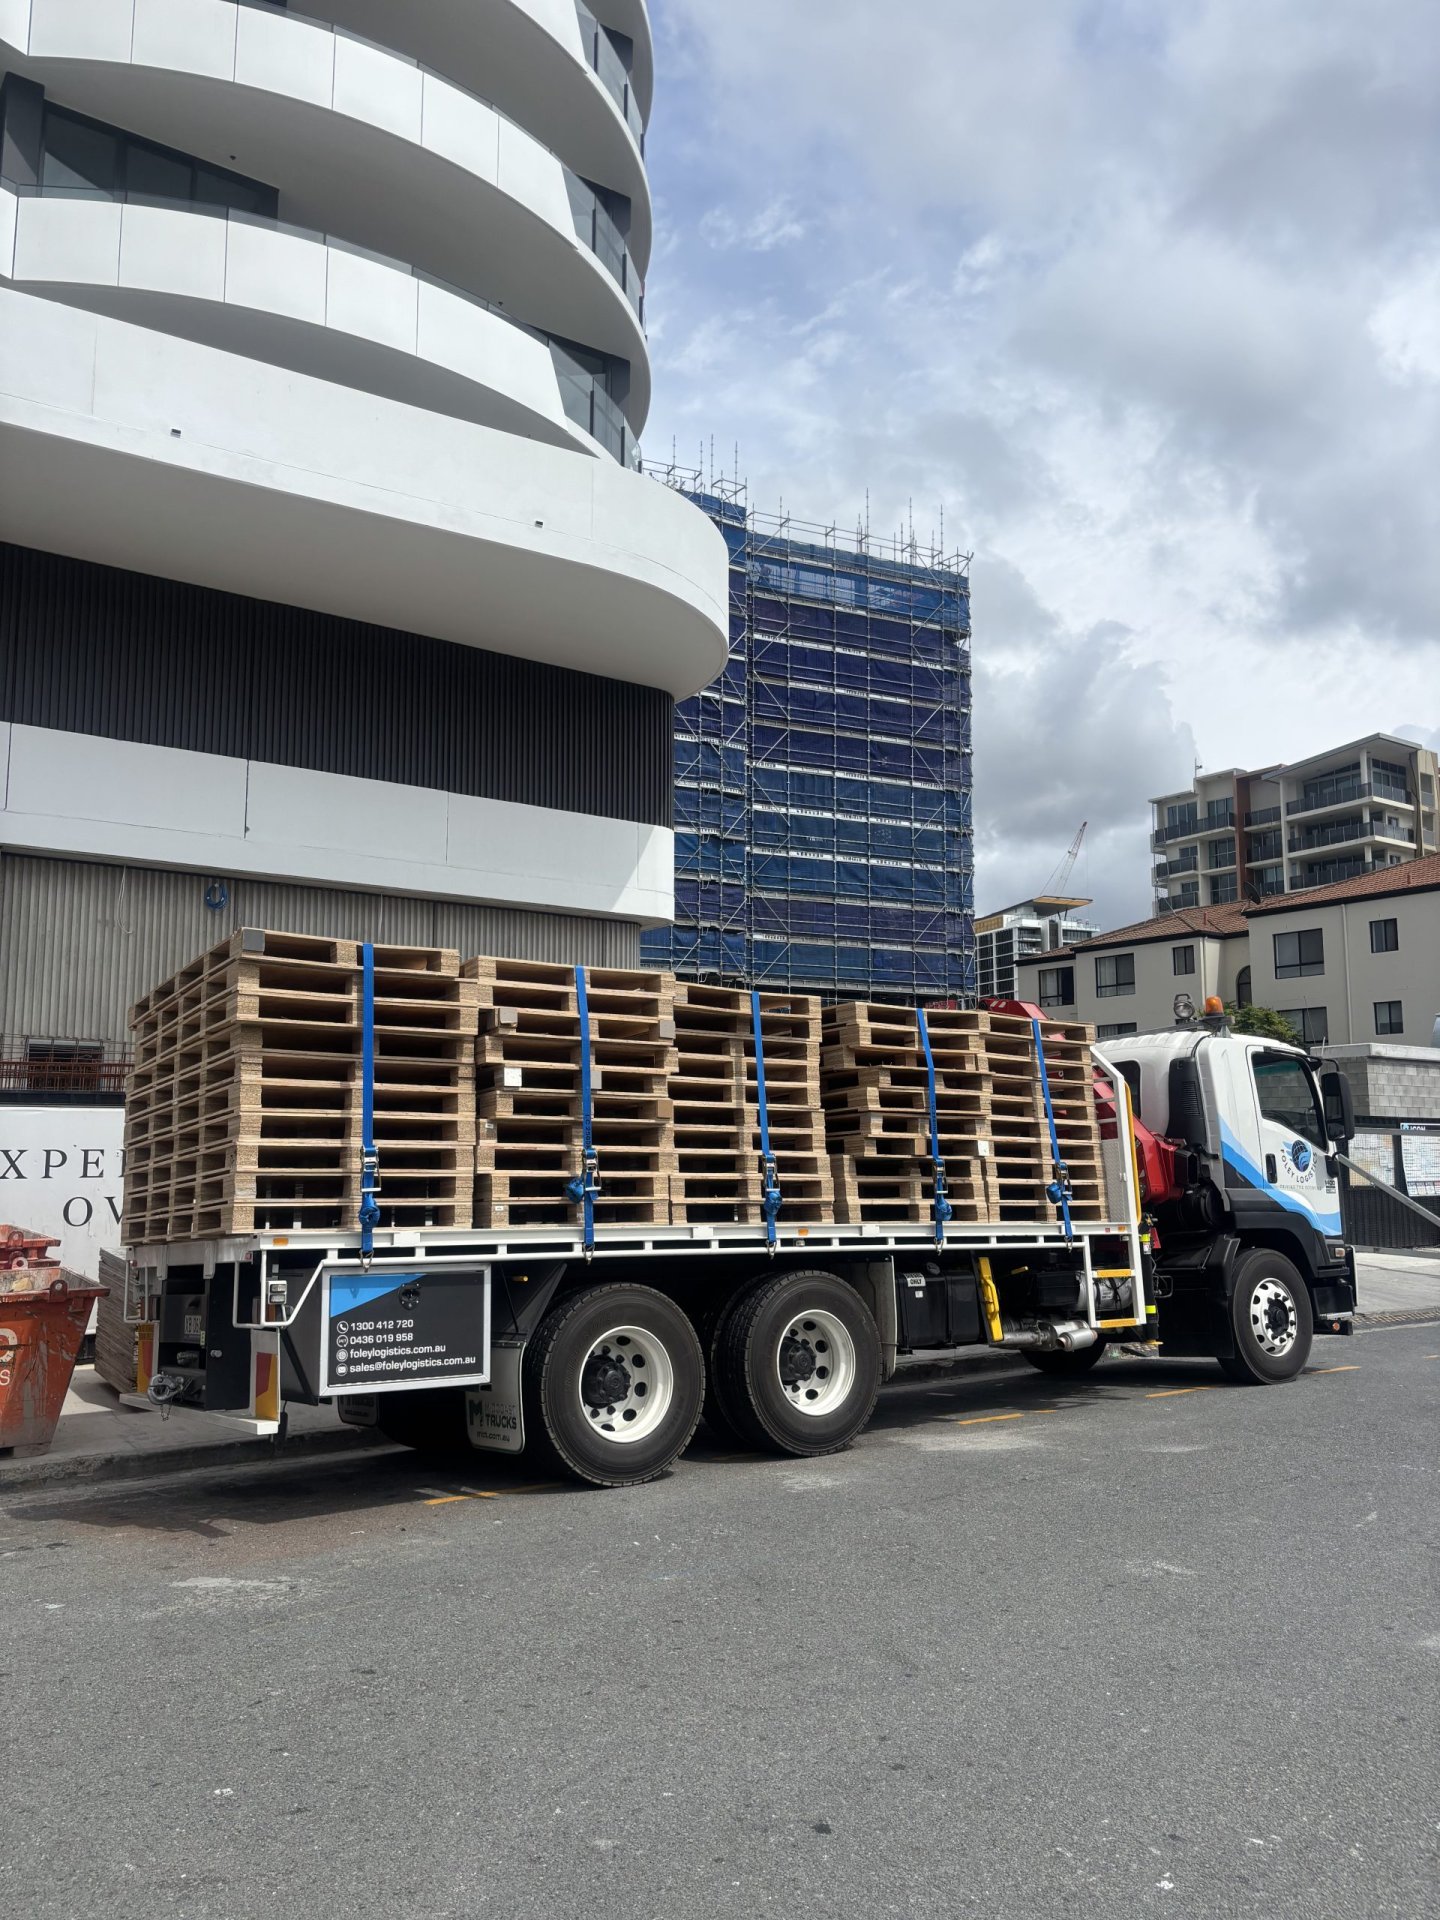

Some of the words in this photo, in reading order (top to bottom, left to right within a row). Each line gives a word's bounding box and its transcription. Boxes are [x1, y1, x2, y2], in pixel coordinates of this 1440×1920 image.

[1280, 1148, 1295, 1178] FOLEY
[1296, 1152, 1318, 1184] LOGISTICS
[350, 1321, 375, 1332] 1300
[376, 1320, 394, 1330] 412
[396, 1319, 414, 1328] 720
[350, 1335, 374, 1345] 0436
[376, 1334, 393, 1343] 019
[395, 1333, 414, 1342] 958
[350, 1345, 446, 1360] foleylogistics.com.au
[350, 1356, 476, 1373] sales@foleylogistics.com.au
[485, 1413, 517, 1430] TRUCKS
